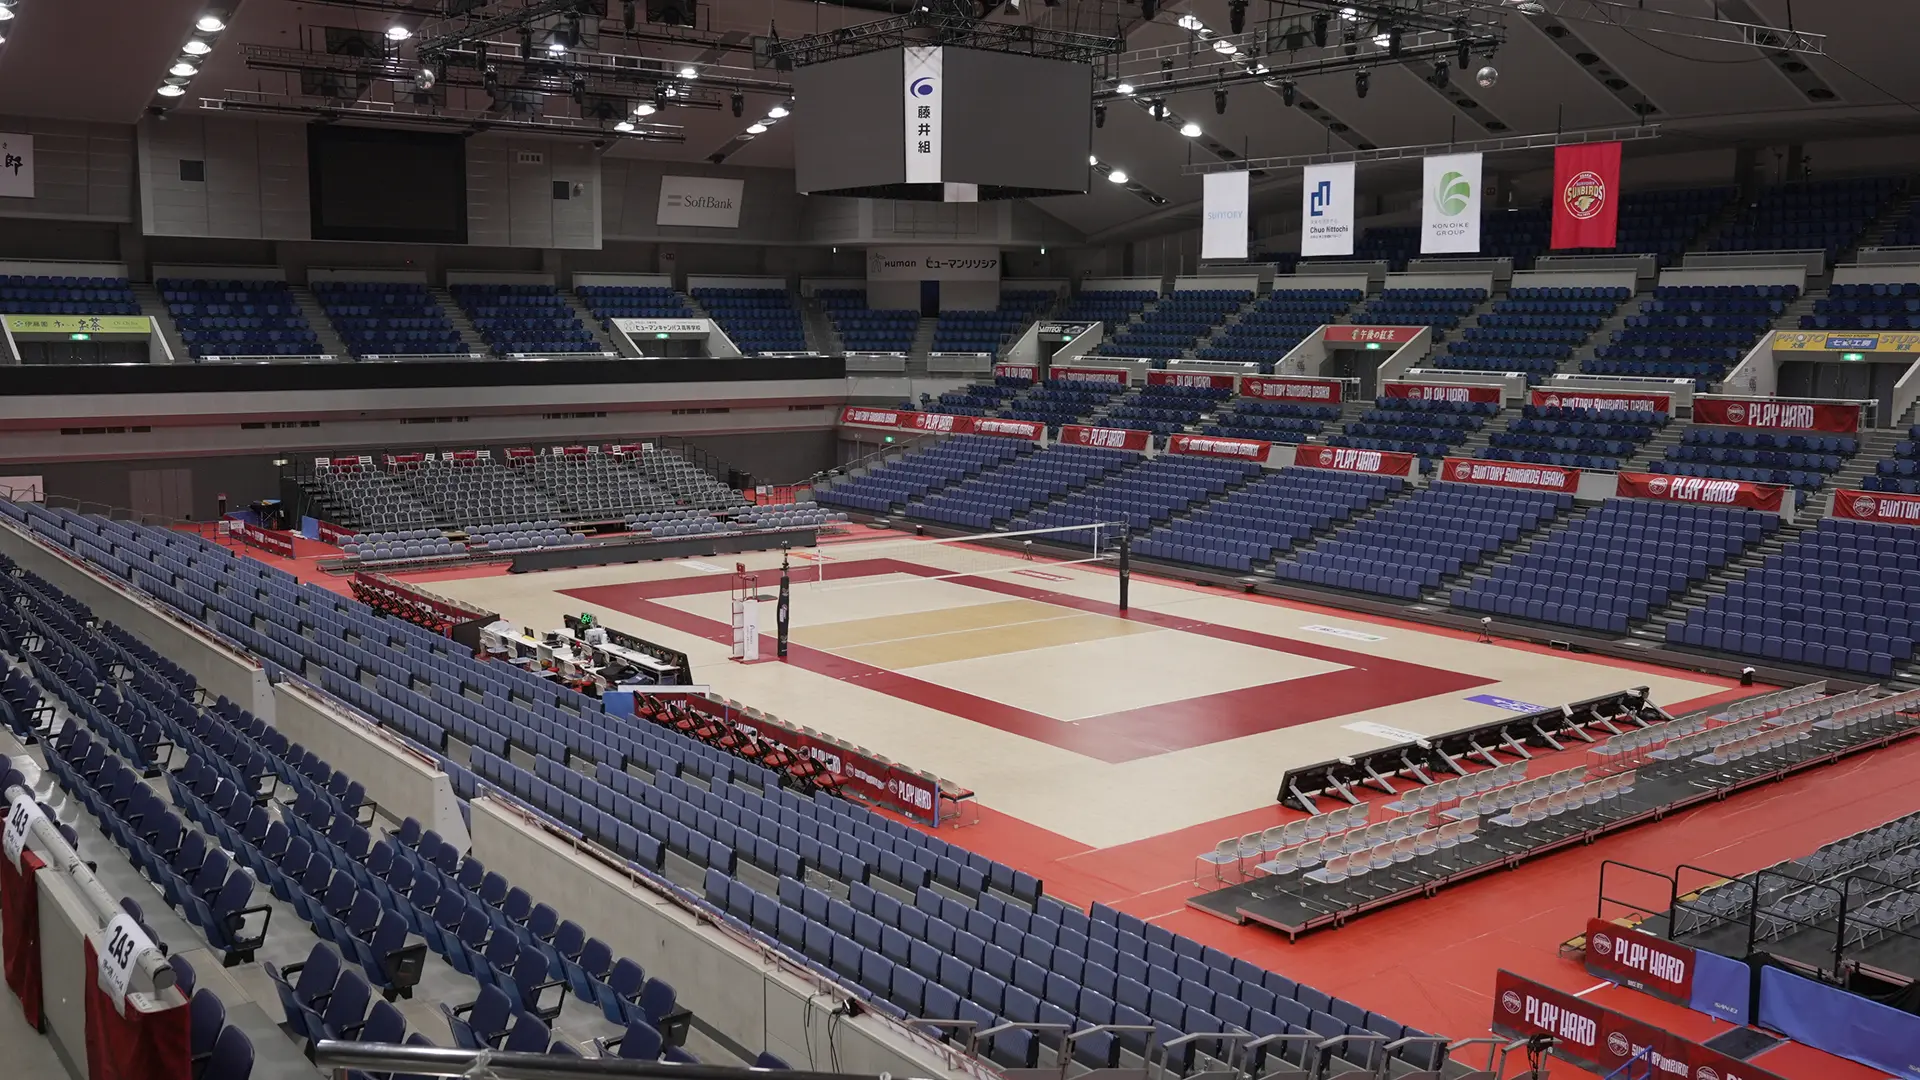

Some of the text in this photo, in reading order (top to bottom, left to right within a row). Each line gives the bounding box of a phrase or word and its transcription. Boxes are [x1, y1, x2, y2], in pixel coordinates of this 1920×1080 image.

[918, 105, 931, 154] 藤井組
[684, 194, 733, 210] SoftBank
[1567, 185, 1603, 203] SUNBIRDS
[1208, 211, 1243, 220] SUNTORY
[1310, 226, 1325, 234] Chuo
[1360, 329, 1395, 341] 午後の紅茶
[1776, 333, 1920, 344] PHOTO STUD
[924, 414, 954, 431] PLAY HARD
[1748, 403, 1813, 428] PLAY HARD
[1090, 428, 1126, 447] PLAY HARD
[1333, 449, 1382, 472] PLAY HARD
[1471, 464, 1566, 488] SUNTORY SUNBIRDS OSAKA
[1669, 477, 1740, 503] PLAY HARD
[898, 780, 932, 810] PLAY HARD
[11, 803, 29, 837] 2A3
[108, 925, 135, 970] 2A3
[1614, 936, 1685, 984] PLAY HARD
[1524, 995, 1597, 1047] PLAY HARD
